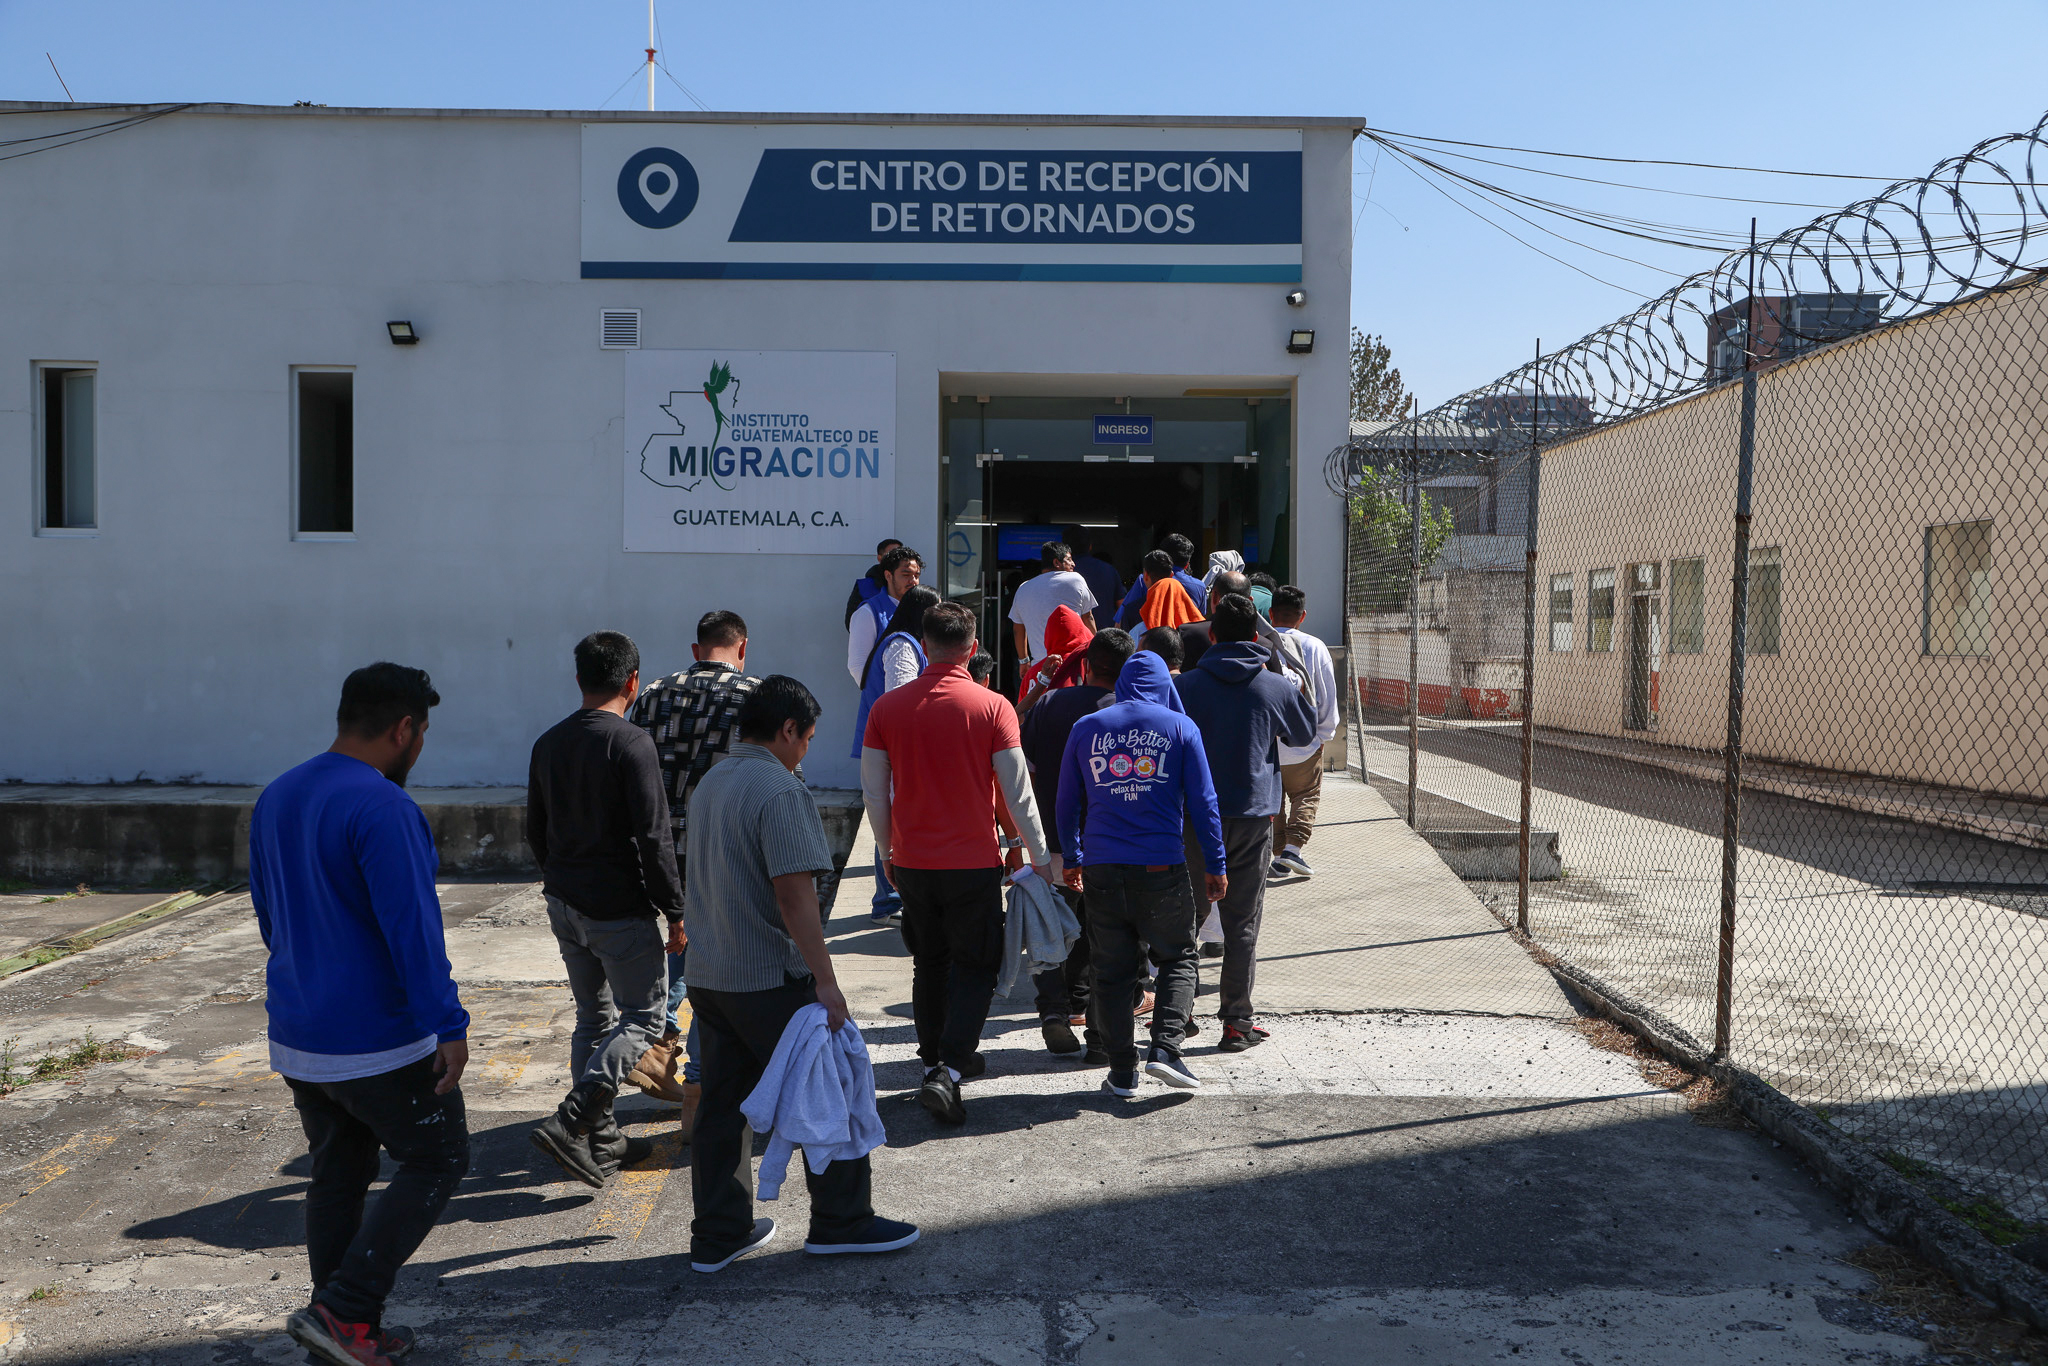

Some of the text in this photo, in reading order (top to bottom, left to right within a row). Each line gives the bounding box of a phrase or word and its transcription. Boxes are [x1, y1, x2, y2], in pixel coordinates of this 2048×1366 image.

[811, 157, 1250, 193] CENTRO DE RECEPCIÓN
[871, 202, 1195, 234] DE RETORNADOS
[731, 414, 809, 427] INSTITUTO
[731, 429, 879, 443] GUATEMALTECO DE
[1098, 425, 1149, 435] INGRESO
[669, 444, 879, 478] MIGRACIÓN
[673, 509, 849, 529] GUATEMALA, C.A.
[1091, 729, 1172, 755] Life is Better
[1133, 747, 1158, 757] by the
[1089, 752, 1169, 783] POOL
[1111, 784, 1151, 795] relax & have
[1124, 792, 1138, 801] FUN
